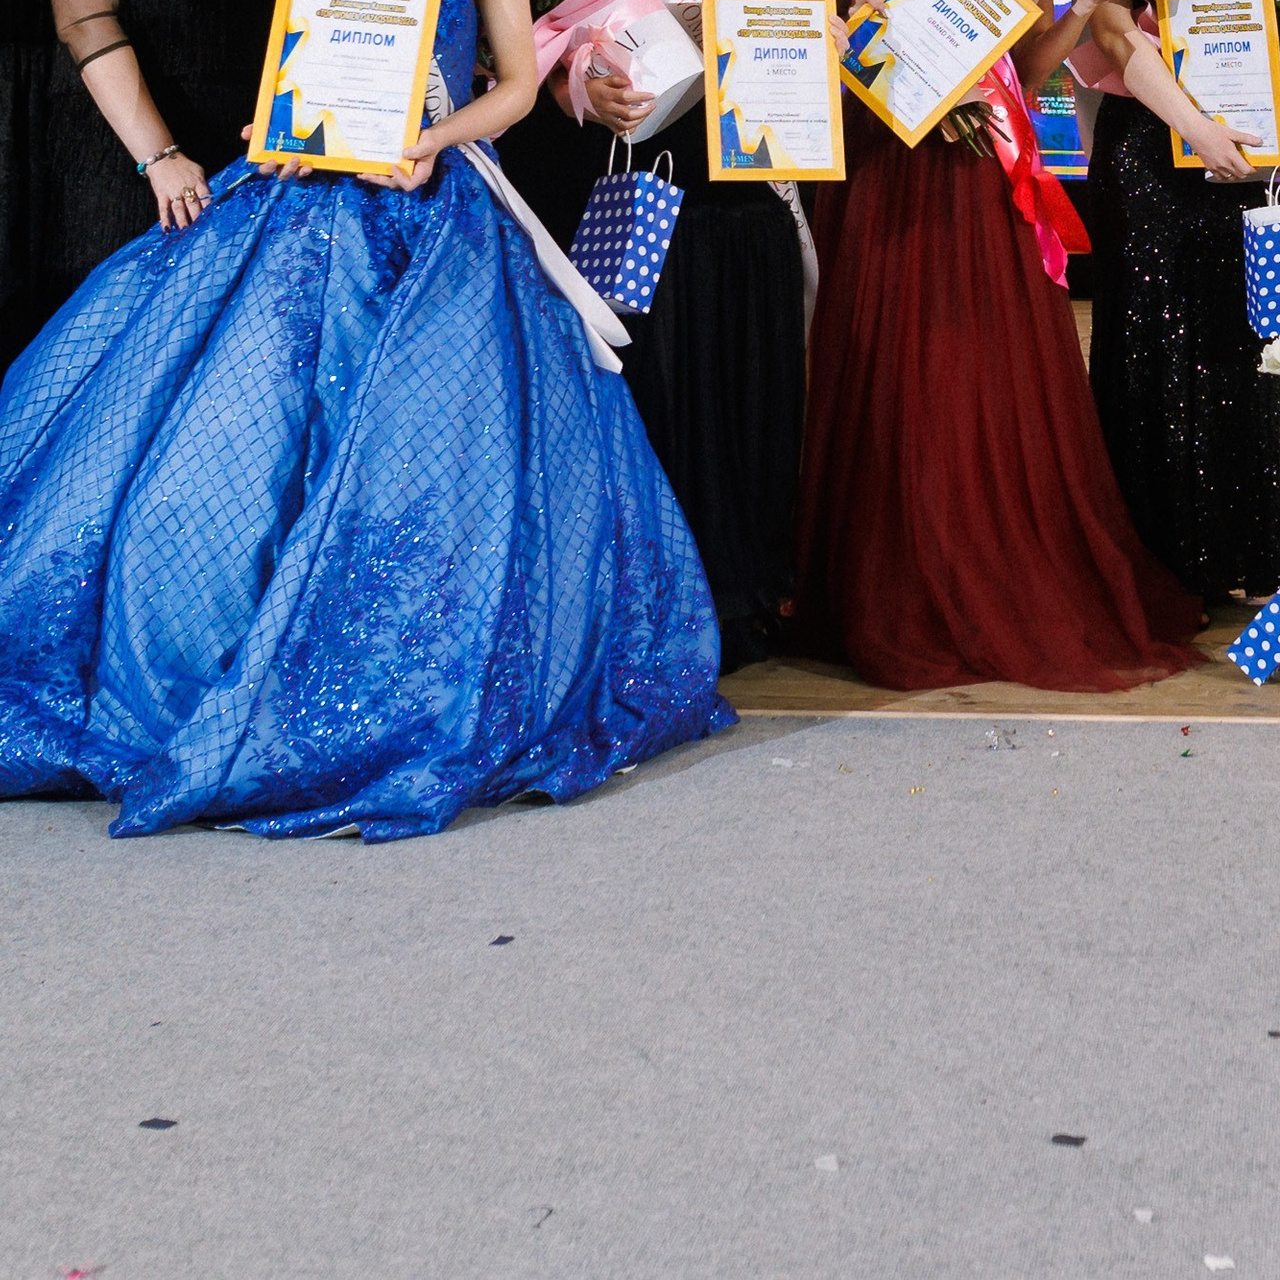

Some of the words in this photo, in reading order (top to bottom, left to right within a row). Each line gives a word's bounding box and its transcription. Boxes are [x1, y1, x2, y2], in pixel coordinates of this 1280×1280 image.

[932, 0, 979, 42] ДИПЛОМ
[330, 29, 396, 47] ДИПЛОМ
[927, 17, 948, 37] GRAND
[946, 35, 960, 48] PRIX
[754, 47, 808, 61] ДИПЛОМ
[1204, 41, 1251, 56] ДИПЛОМ
